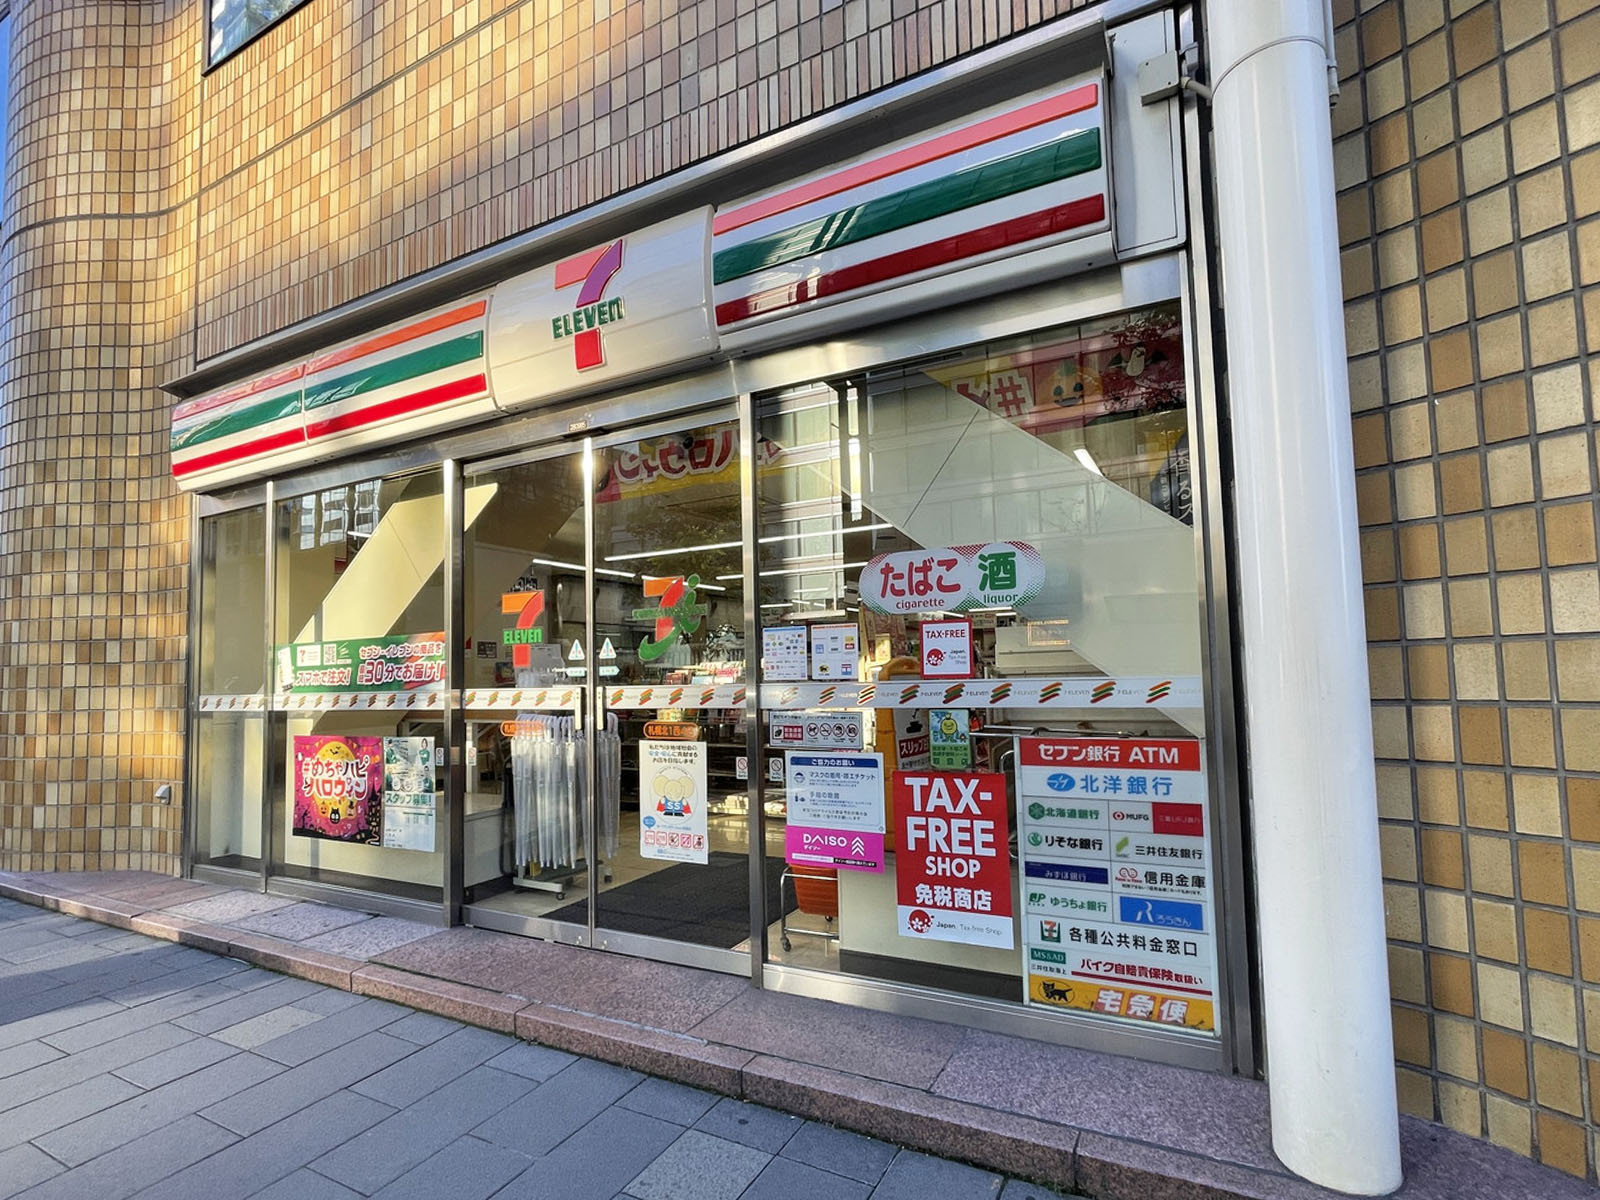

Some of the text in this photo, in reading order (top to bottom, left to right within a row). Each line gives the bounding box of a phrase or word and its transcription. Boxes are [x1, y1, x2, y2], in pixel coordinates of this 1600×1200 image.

[880, 551, 1017, 598] たばこ 酒
[895, 592, 1019, 611] cigarette liquor
[1038, 744, 1179, 764] セブン銀行 ATM
[1080, 775, 1173, 795] 北洋銀行
[904, 777, 993, 815] TAX-
[1045, 807, 1100, 820] 北海道銀行
[1126, 813, 1150, 821] MUFG
[803, 833, 847, 847] DAISO
[906, 816, 997, 857] FREE
[1045, 835, 1103, 851] りそな銀行
[1135, 845, 1203, 860] 三井住友銀行
[925, 856, 981, 879] SHOP
[1045, 870, 1087, 882] みずほ銀行
[1144, 871, 1206, 889] 信用金庫
[915, 883, 992, 911] 免税商店
[1050, 897, 1107, 912] ゆうちょ銀行
[1156, 914, 1192, 927] ろうきん
[1069, 926, 1198, 957] 各種公共料金窓口
[1081, 958, 1203, 985] バイク自賠責保険取扱い
[1097, 989, 1188, 1025] 宅急便
